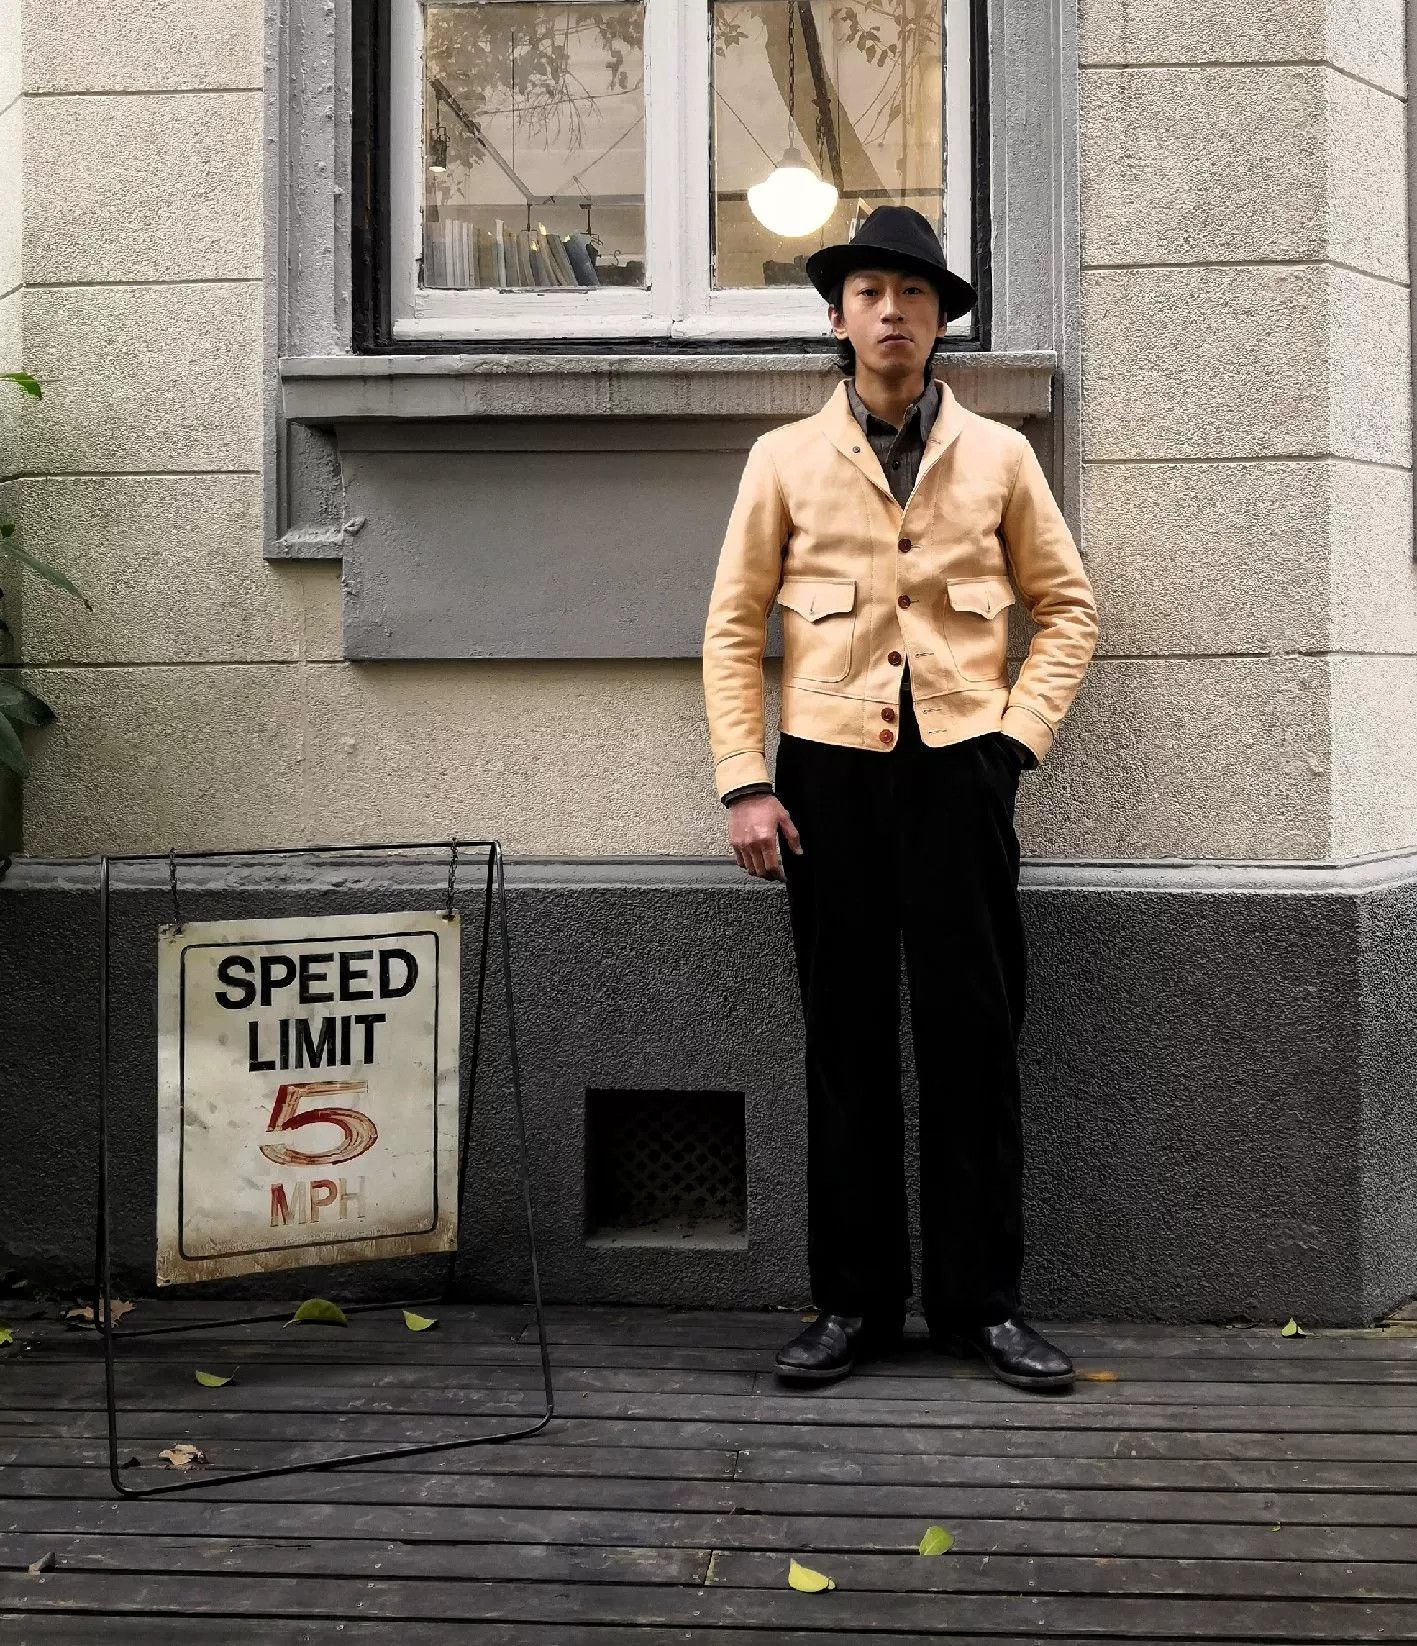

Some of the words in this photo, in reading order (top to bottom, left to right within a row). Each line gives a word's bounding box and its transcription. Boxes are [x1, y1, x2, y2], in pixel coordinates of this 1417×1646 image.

[215, 948, 419, 1010] SPEED
[248, 1013, 387, 1073] LIMIT
[259, 1080, 379, 1166] 5
[269, 1175, 366, 1228] MPH
